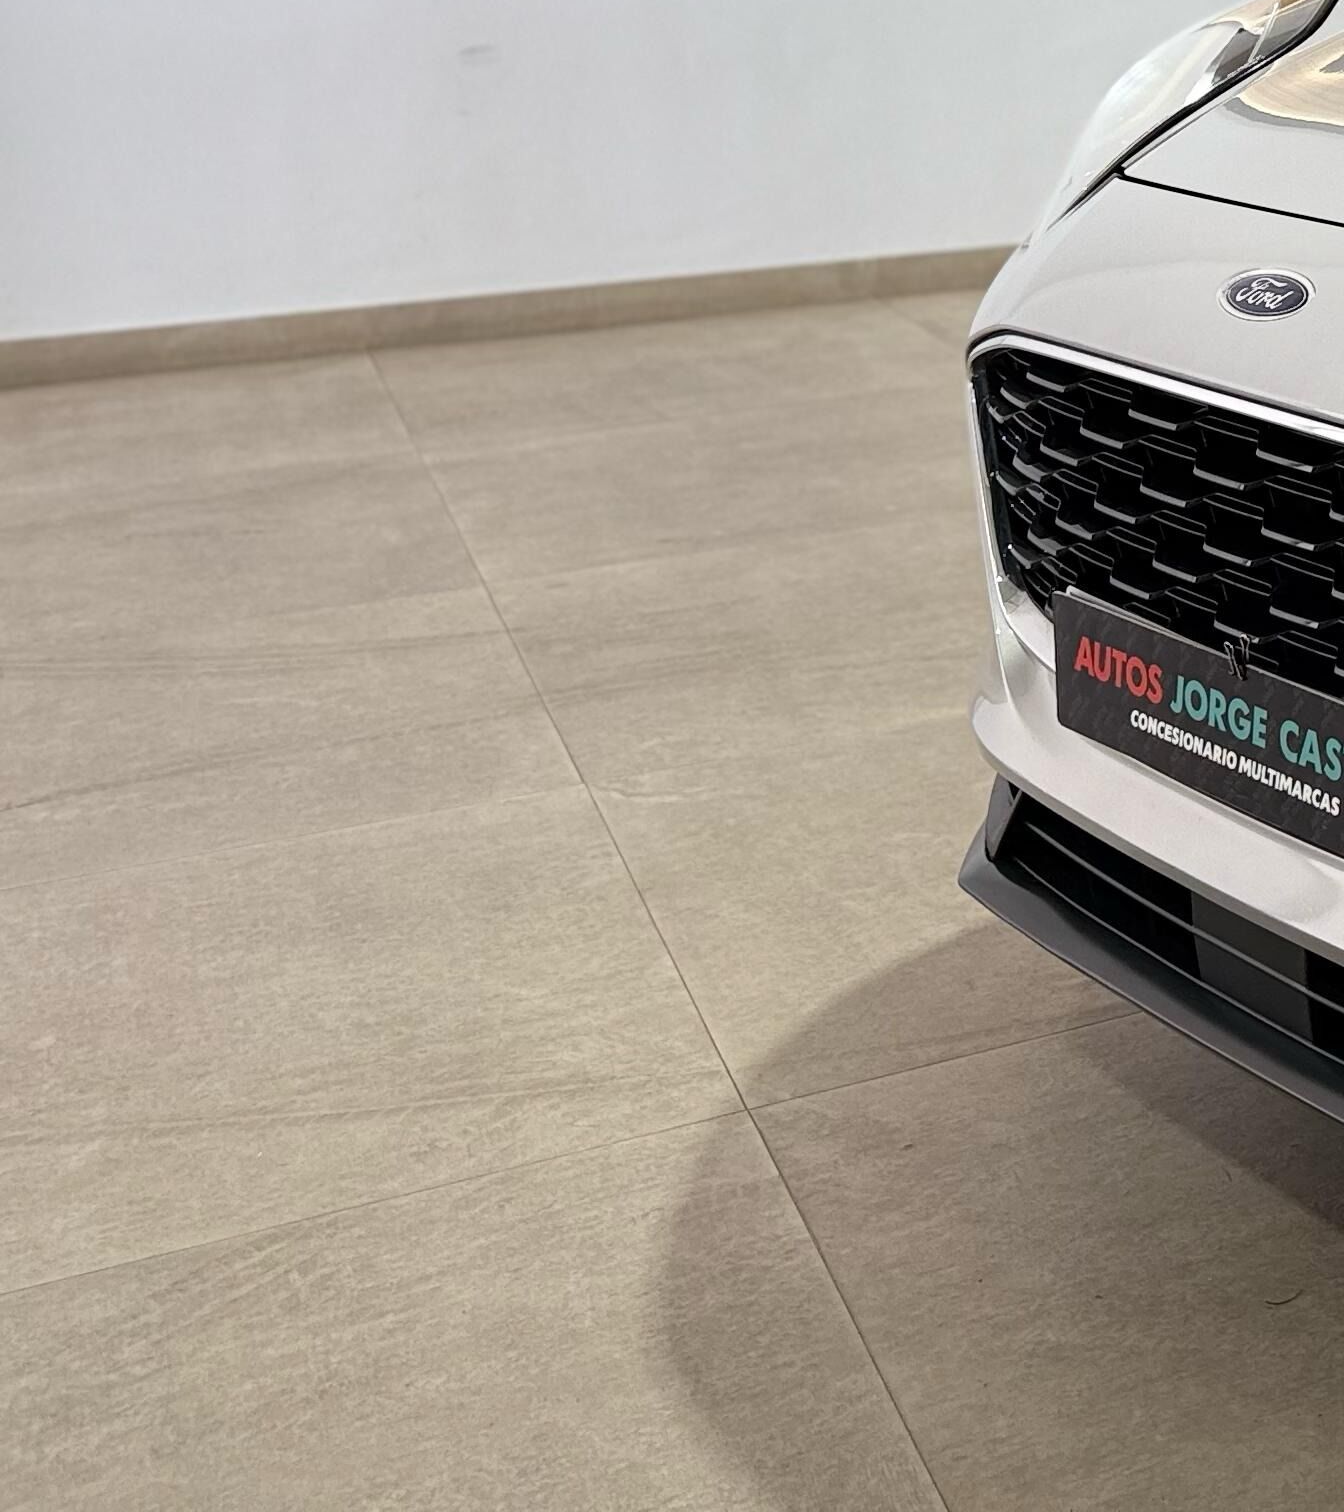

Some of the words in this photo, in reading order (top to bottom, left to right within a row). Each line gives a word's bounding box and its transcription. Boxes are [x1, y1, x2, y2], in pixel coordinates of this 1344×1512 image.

[1235, 277, 1294, 309] Ford
[1074, 636, 1163, 704] AUTOS
[1170, 675, 1268, 749] JORGE
[1130, 709, 1238, 770] CONCESIONARIO
[1238, 757, 1341, 816] MULTIMARCAS
